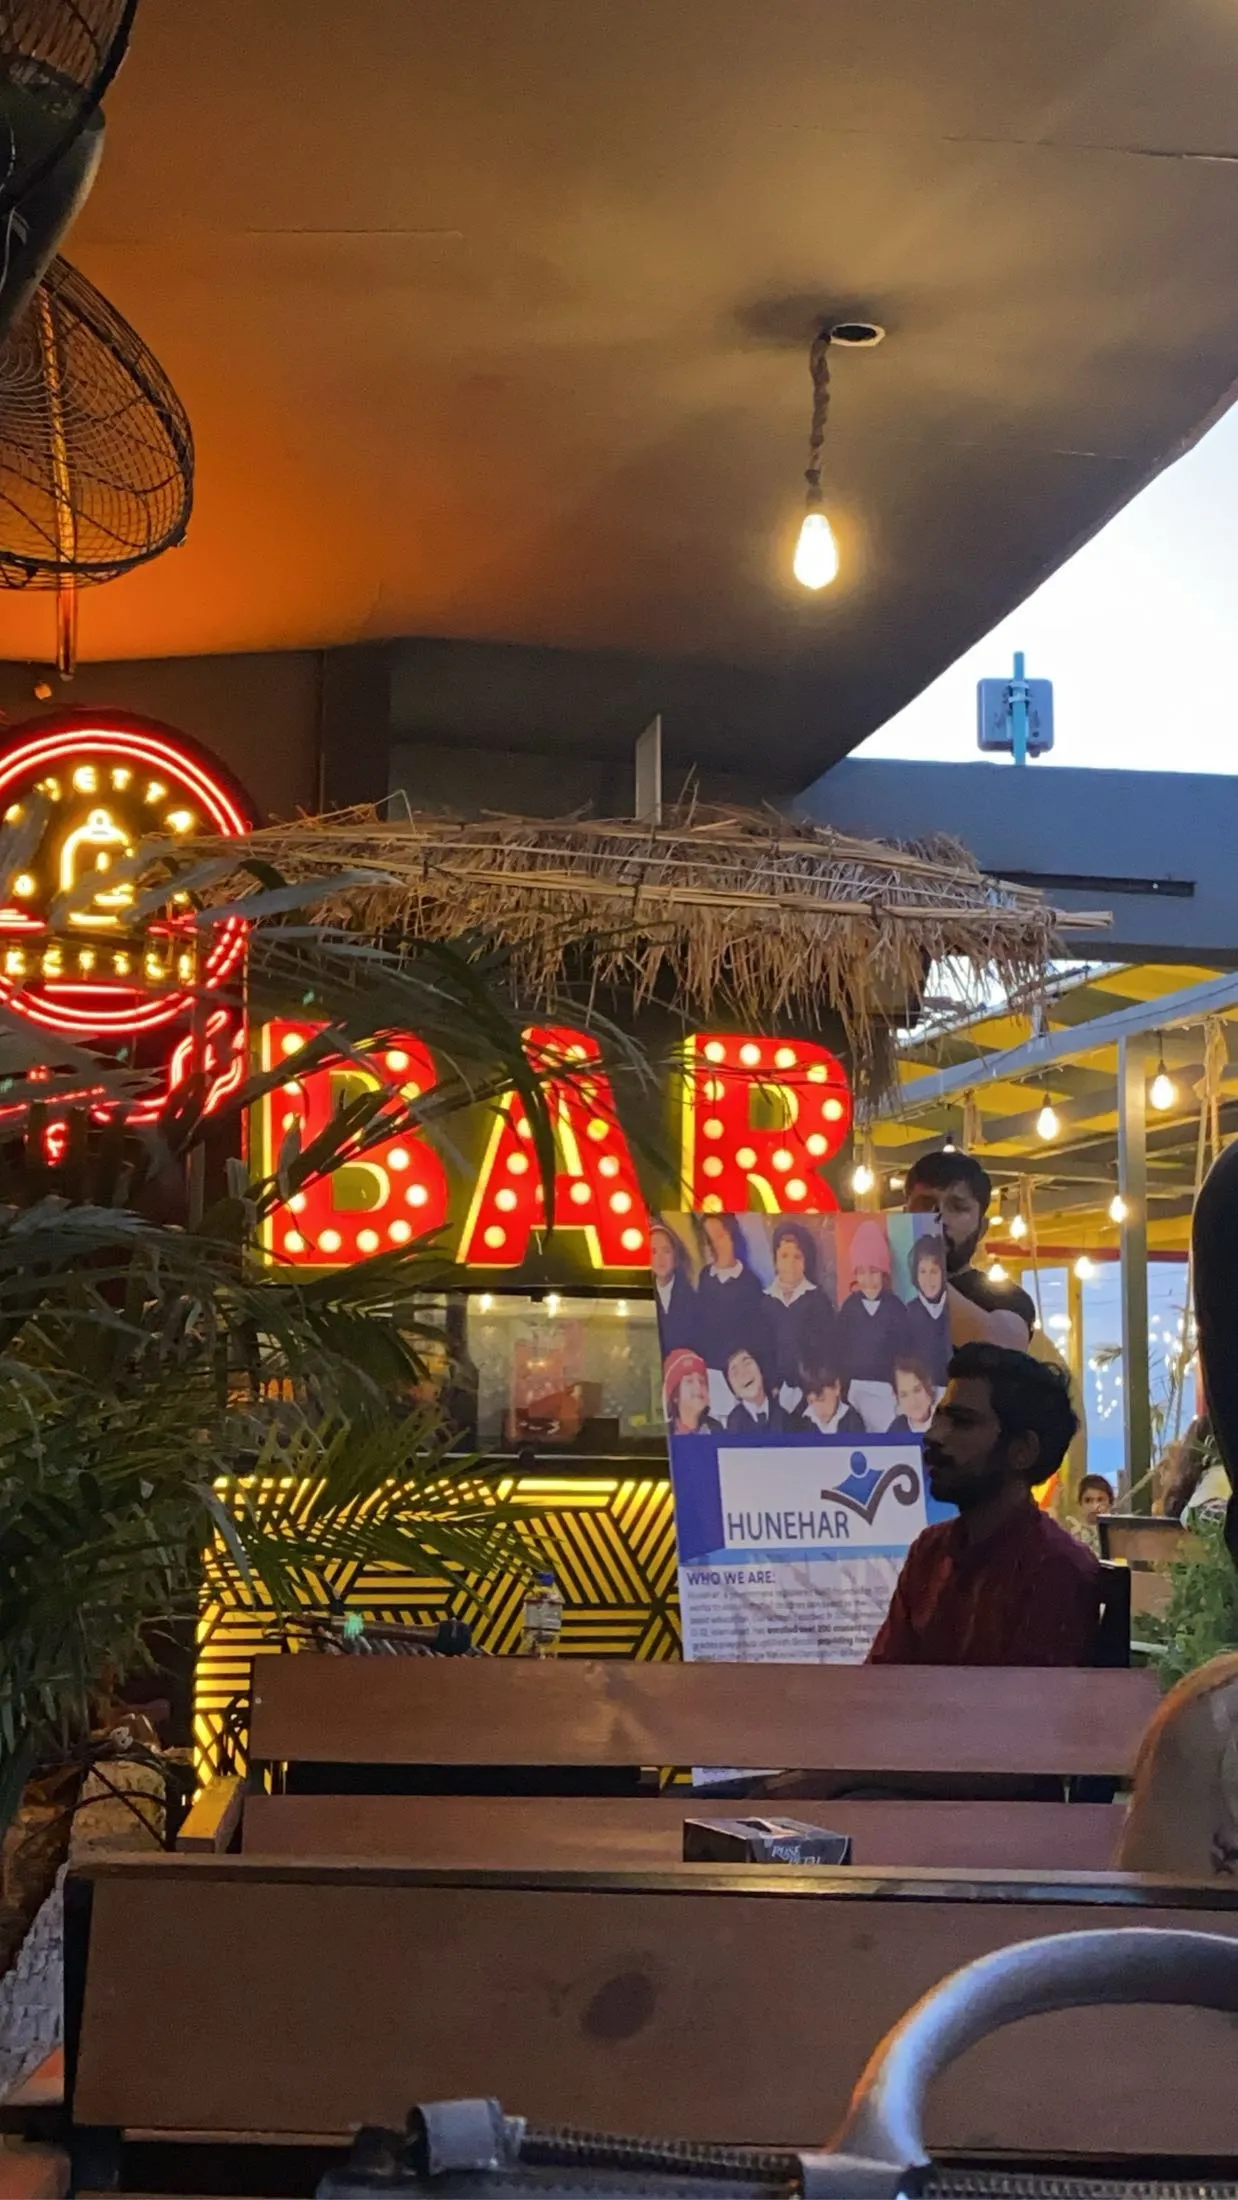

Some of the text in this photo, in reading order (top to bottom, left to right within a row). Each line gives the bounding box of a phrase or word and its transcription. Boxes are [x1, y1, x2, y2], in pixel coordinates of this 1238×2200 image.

[262, 1018, 852, 1270] BAR
[727, 1510, 850, 1541] HUNEHAR
[687, 1570, 776, 1586] WHO WE ARE:
